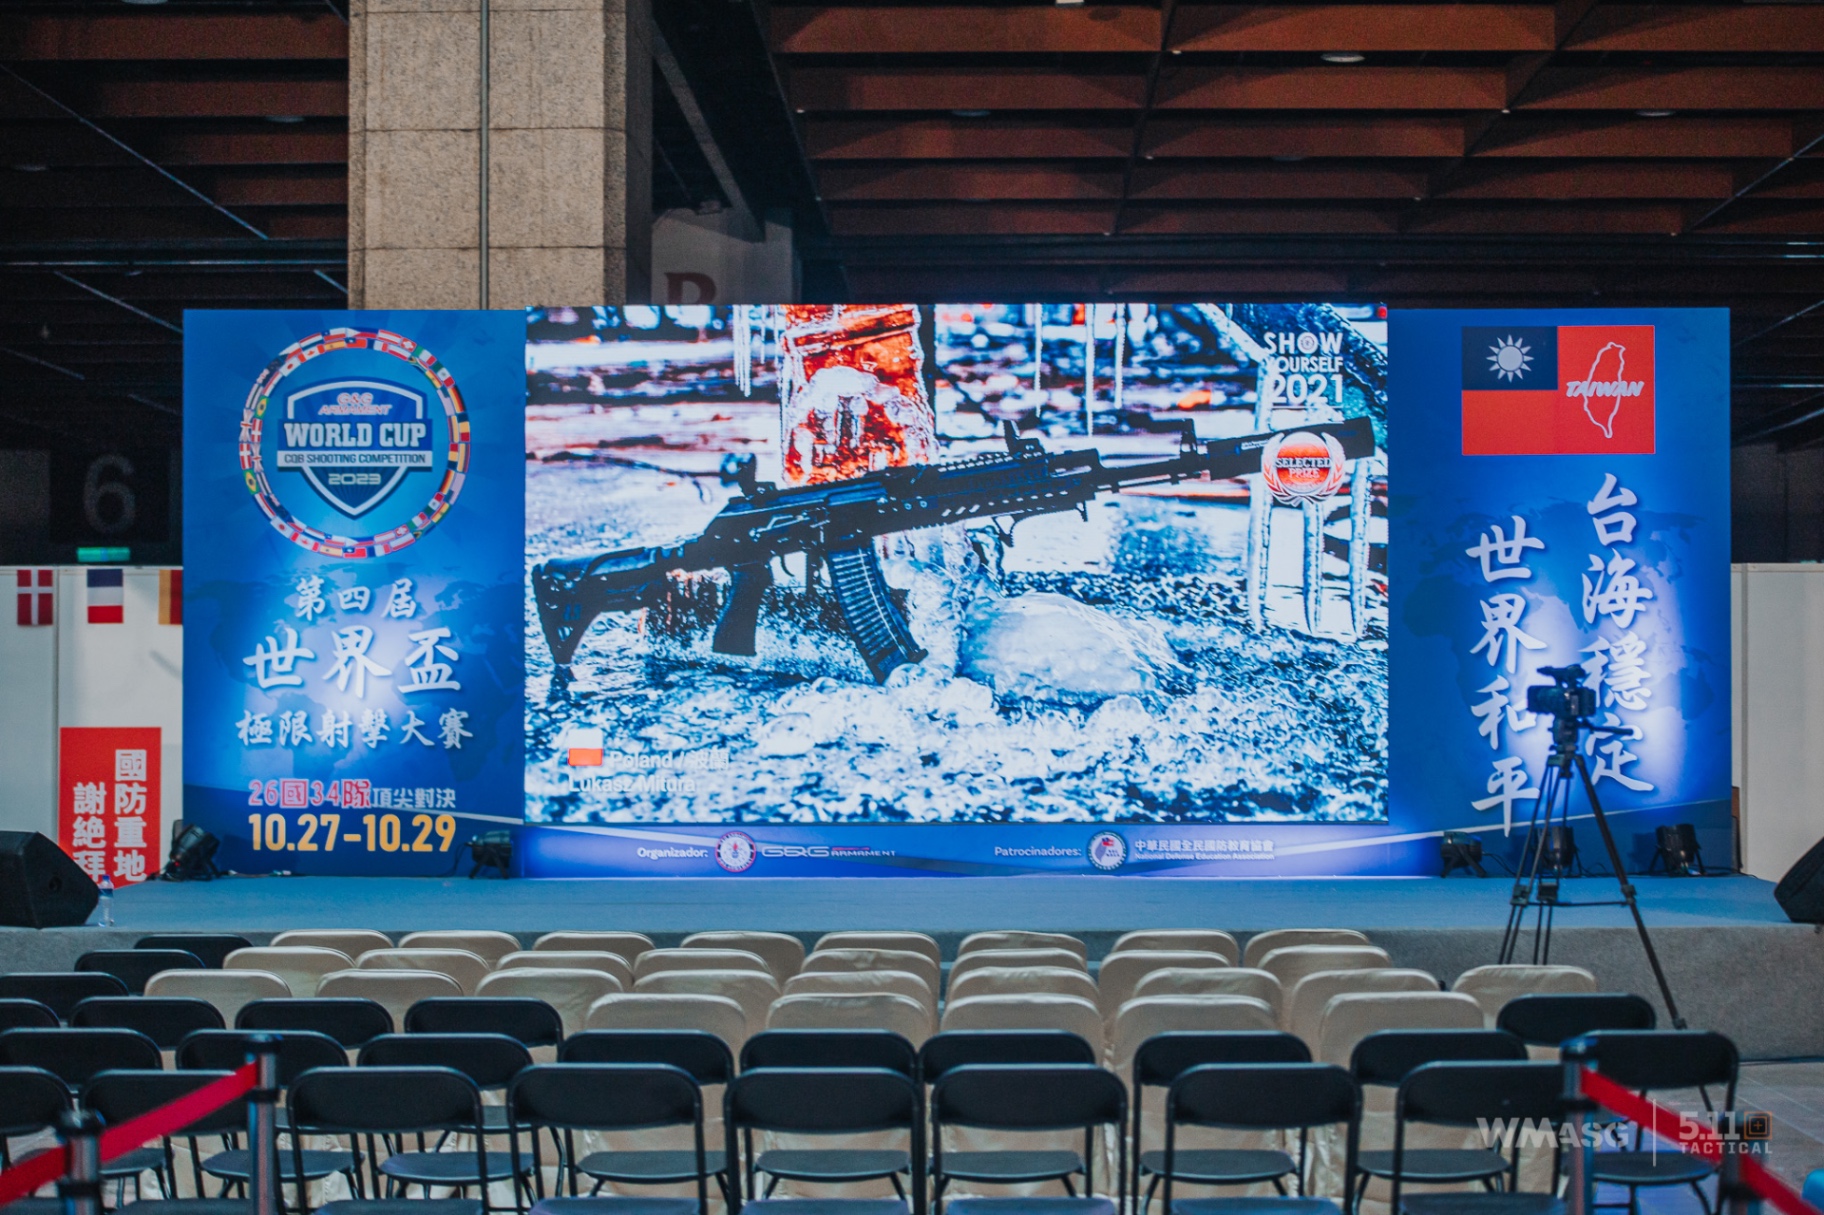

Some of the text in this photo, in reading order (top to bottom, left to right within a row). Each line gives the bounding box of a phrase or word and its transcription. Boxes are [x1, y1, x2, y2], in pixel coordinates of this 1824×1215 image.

[1264, 332, 1343, 354] SHOW
[1268, 356, 1343, 373] YOURSELF
[337, 393, 373, 404] G&G
[1272, 374, 1343, 404] 2021
[1566, 381, 1645, 397] TAIWAN
[318, 404, 392, 415] ARMAMENT
[284, 423, 426, 447] WORLD CUP
[284, 454, 426, 464] CQB SHOOTING COMPETITION
[1275, 457, 1331, 468] SELECTED
[328, 473, 381, 485] 2023
[1288, 468, 1320, 479] PRIZE
[83, 454, 136, 533] 6
[295, 575, 417, 622] 第四屆
[1580, 473, 1654, 791] 台海穩定
[242, 624, 462, 699] 世界盃
[1466, 515, 1548, 838] 世界和平
[235, 708, 474, 749] 極限射擊大賽
[610, 750, 674, 769] Poland
[640, 774, 696, 793] Mitura
[113, 749, 148, 882] 國防重地
[249, 813, 457, 852] 10.27-10.29
[637, 847, 708, 859] Organizador:
[994, 847, 1082, 857] Patrocinadores:
